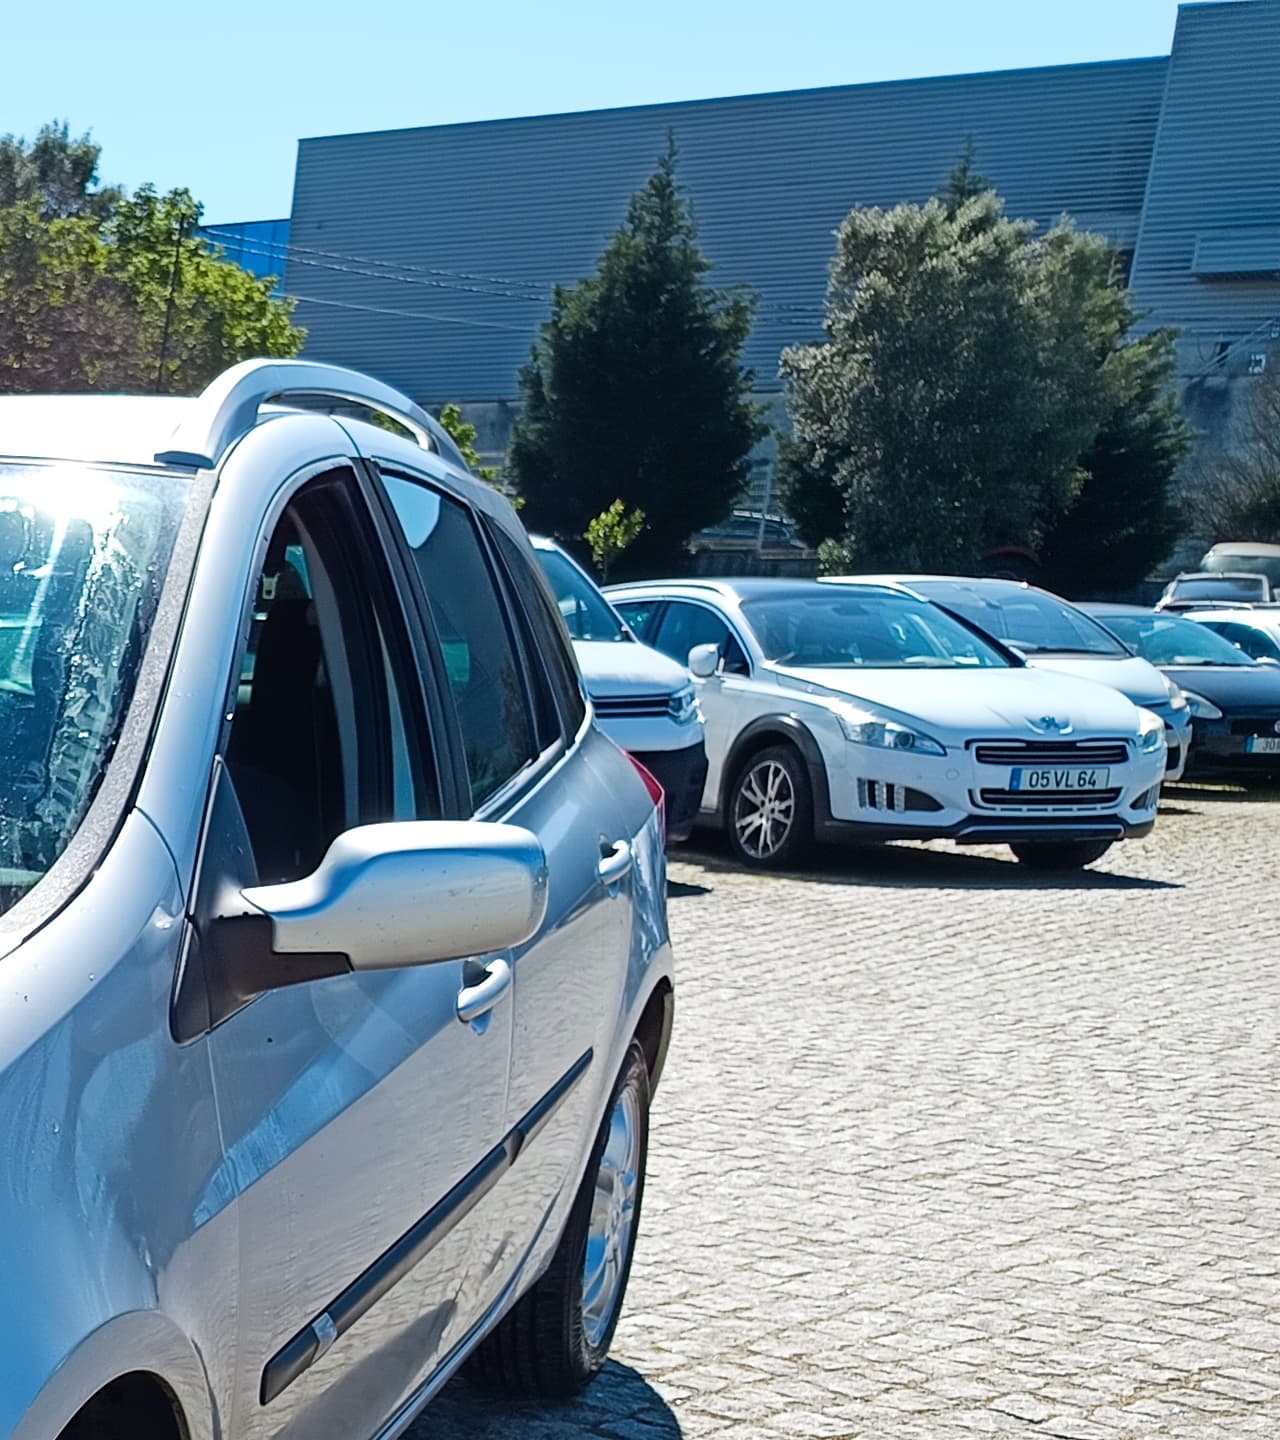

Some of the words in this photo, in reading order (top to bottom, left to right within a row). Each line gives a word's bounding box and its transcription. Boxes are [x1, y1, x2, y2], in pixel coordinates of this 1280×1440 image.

[1029, 771, 1050, 788] 05
[1054, 770, 1075, 787] VL
[1077, 770, 1097, 787] 64
